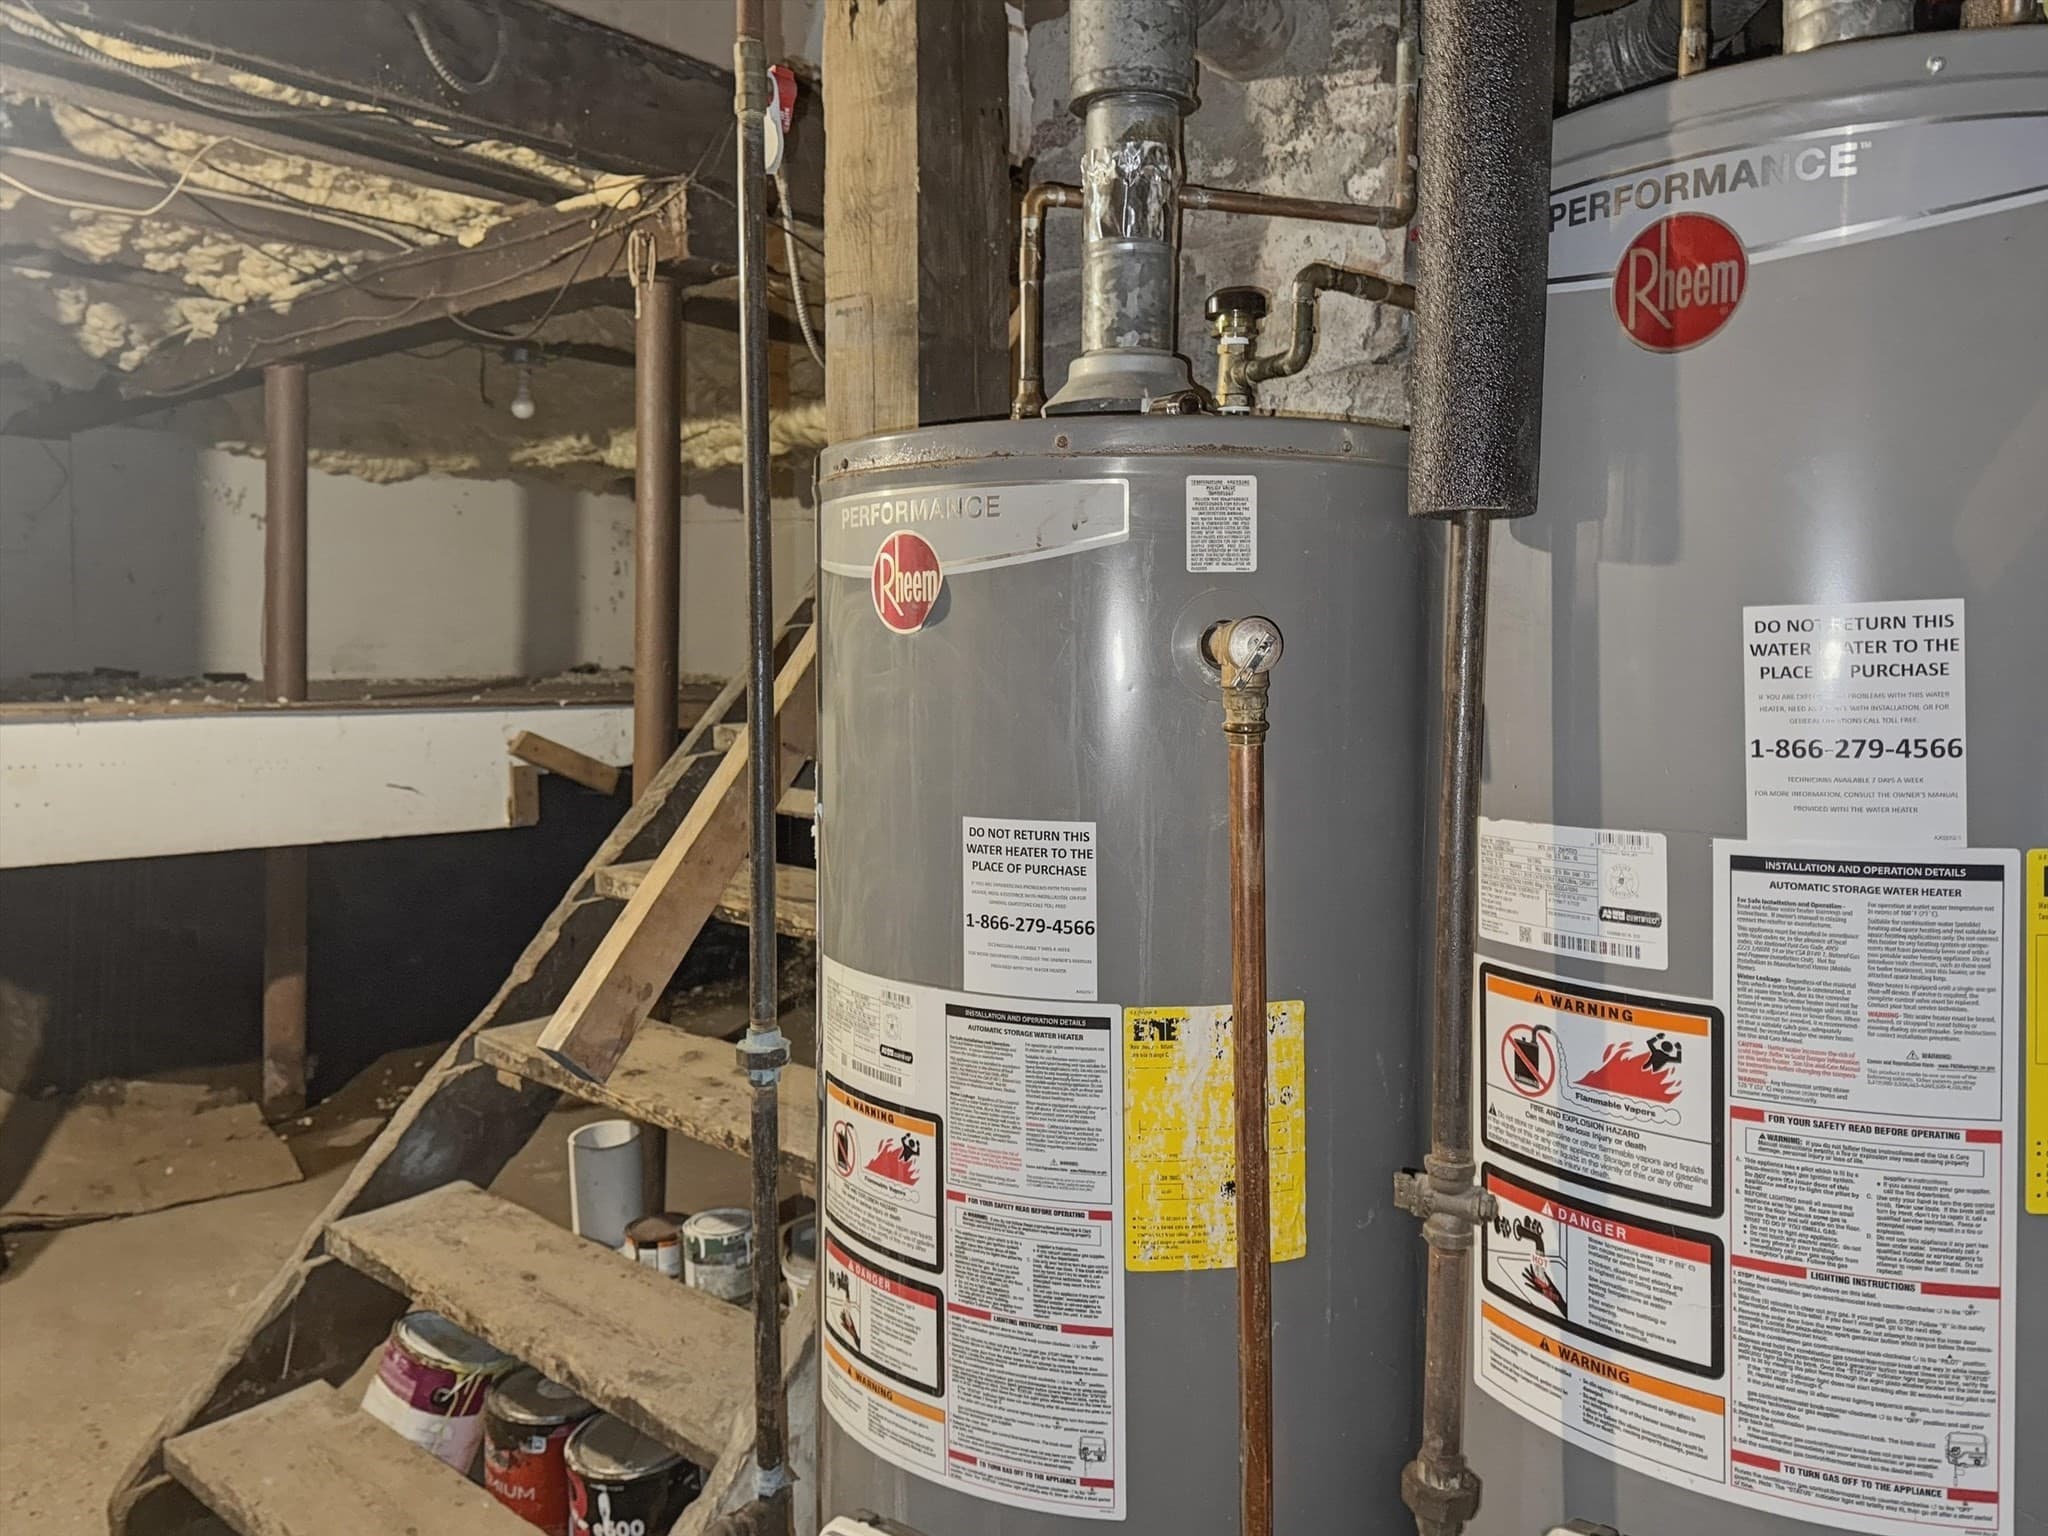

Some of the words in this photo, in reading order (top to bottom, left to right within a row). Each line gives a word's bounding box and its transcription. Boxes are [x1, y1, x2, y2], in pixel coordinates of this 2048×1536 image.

[1628, 219, 1738, 331] Rheem
[841, 495, 1001, 529] PERFORMANCE
[880, 535, 938, 617] Rheem
[1754, 620, 1781, 634] DO
[1912, 614, 1954, 628] THIS
[1750, 642, 1811, 656] WATER
[1832, 640, 1887, 655] ATER
[1892, 639, 1917, 653] TO
[1923, 638, 1960, 652] THE
[1760, 665, 1813, 679] PLACE
[1850, 662, 1950, 678] PURCHASE
[1751, 738, 1963, 759] 1-866-279-4566
[1833, 776, 1870, 784] AVAILABLE
[1843, 791, 1875, 799] CONSULT
[1928, 791, 1959, 799] MANUAL
[969, 826, 985, 838] DO
[988, 828, 1011, 840] NOT
[1013, 829, 1060, 841] RETURN
[1063, 831, 1090, 842] THIS
[966, 843, 1002, 856] WATER
[1005, 845, 1049, 859] HEATER
[1050, 847, 1067, 859] TO
[1070, 848, 1094, 860] THE
[972, 860, 1004, 873] PLACE
[1006, 862, 1022, 874] OF
[1024, 863, 1088, 877] PURCHASE
[1765, 859, 1836, 873] INSTALLATION
[1837, 865, 1860, 874] AND
[1863, 865, 1923, 877] OPERATION
[1924, 867, 1967, 878] DETAILS
[1769, 880, 1831, 893] AUTOMATIC
[1832, 883, 1881, 895] STORAGE
[1882, 886, 1919, 897] WATER
[1921, 887, 1962, 898] HEATER
[966, 912, 1096, 936] 1-866-279-4566
[965, 1009, 1006, 1021] INSTALLATION
[1022, 1016, 1059, 1026] OPERATION
[1059, 1018, 1087, 1027] DETAILS
[1550, 994, 1633, 1022] WARNING
[968, 1024, 1002, 1035] AUTOMATIC
[1003, 1028, 1034, 1038] STORAGE
[1033, 1031, 1057, 1040] WATER
[1057, 1032, 1084, 1041] HEATER
[852, 1099, 895, 1125] WARNING
[1575, 1092, 1622, 1110] Flammable
[1624, 1103, 1656, 1117] Vapors
[1530, 1103, 1545, 1114] FIRE
[1546, 1109, 1561, 1119] AND
[1562, 1113, 1604, 1131] EXPLOSION
[1606, 1125, 1640, 1140] HAZARD
[1768, 1114, 1785, 1125] FOR
[1787, 1116, 1811, 1128] YOUR
[1812, 1119, 1846, 1131] SAFETY
[1848, 1123, 1872, 1134] READ
[1874, 1126, 1908, 1137] BEFORE
[1911, 1129, 1961, 1141] OPERATING
[1565, 1125, 1591, 1137] serious
[1625, 1140, 1647, 1152] death
[1636, 1154, 1661, 1167] vapors
[1662, 1159, 1678, 1170] and
[1680, 1163, 1705, 1175] liquids
[1641, 1164, 1649, 1172] or
[1650, 1166, 1665, 1176] use
[1657, 1177, 1672, 1188] any
[1672, 1179, 1695, 1191] other
[994, 1201, 1015, 1212] SAFETY
[1557, 1207, 1627, 1240] DANGER
[855, 1264, 891, 1292] DANGER
[1811, 1271, 1850, 1285] LIGHTING
[1852, 1277, 1916, 1293] INSTRUCTIONS
[1558, 1345, 1631, 1384] WARNING
[855, 1370, 894, 1401] WARNING
[1784, 1465, 1796, 1475] TO
[1797, 1468, 1820, 1480] TURN
[1822, 1473, 1840, 1484] GAS
[1841, 1476, 1858, 1487] OFF
[1861, 1479, 1873, 1489] TO
[1875, 1481, 1892, 1492] THE
[1893, 1484, 1942, 1498] APPLIANCE
